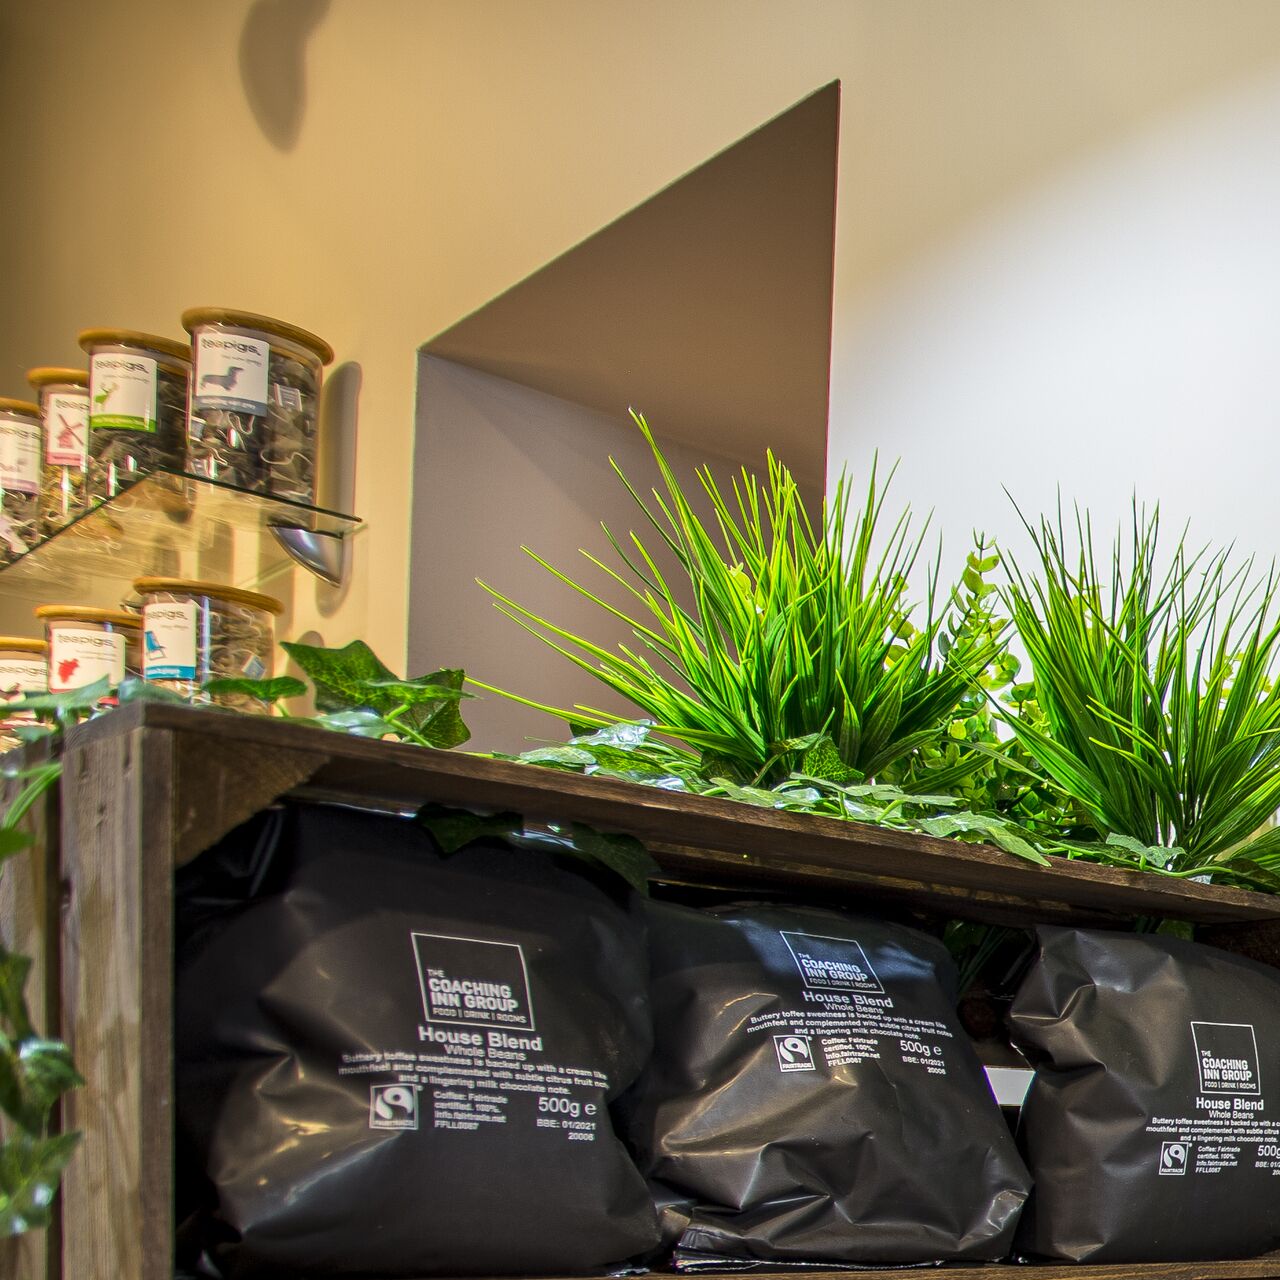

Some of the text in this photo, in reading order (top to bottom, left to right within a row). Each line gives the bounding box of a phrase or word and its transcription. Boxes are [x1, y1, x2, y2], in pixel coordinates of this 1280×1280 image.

[801, 959, 861, 974] COACHING
[805, 966, 868, 983] INN GROUP
[428, 978, 512, 999] COACHING
[430, 992, 518, 1013] INN GROUP
[803, 991, 894, 1009] House Blend
[824, 1002, 885, 1016] Whole Beans
[418, 1024, 543, 1052] House Blend
[444, 1044, 527, 1061] Whole Beans
[899, 1039, 931, 1057] 500g
[1202, 1057, 1248, 1070] COACHING
[1203, 1069, 1252, 1081] INN GROUP
[538, 1096, 582, 1118] 500g
[1195, 1097, 1264, 1111] House Blend
[1208, 1109, 1254, 1120] Whole Beans
